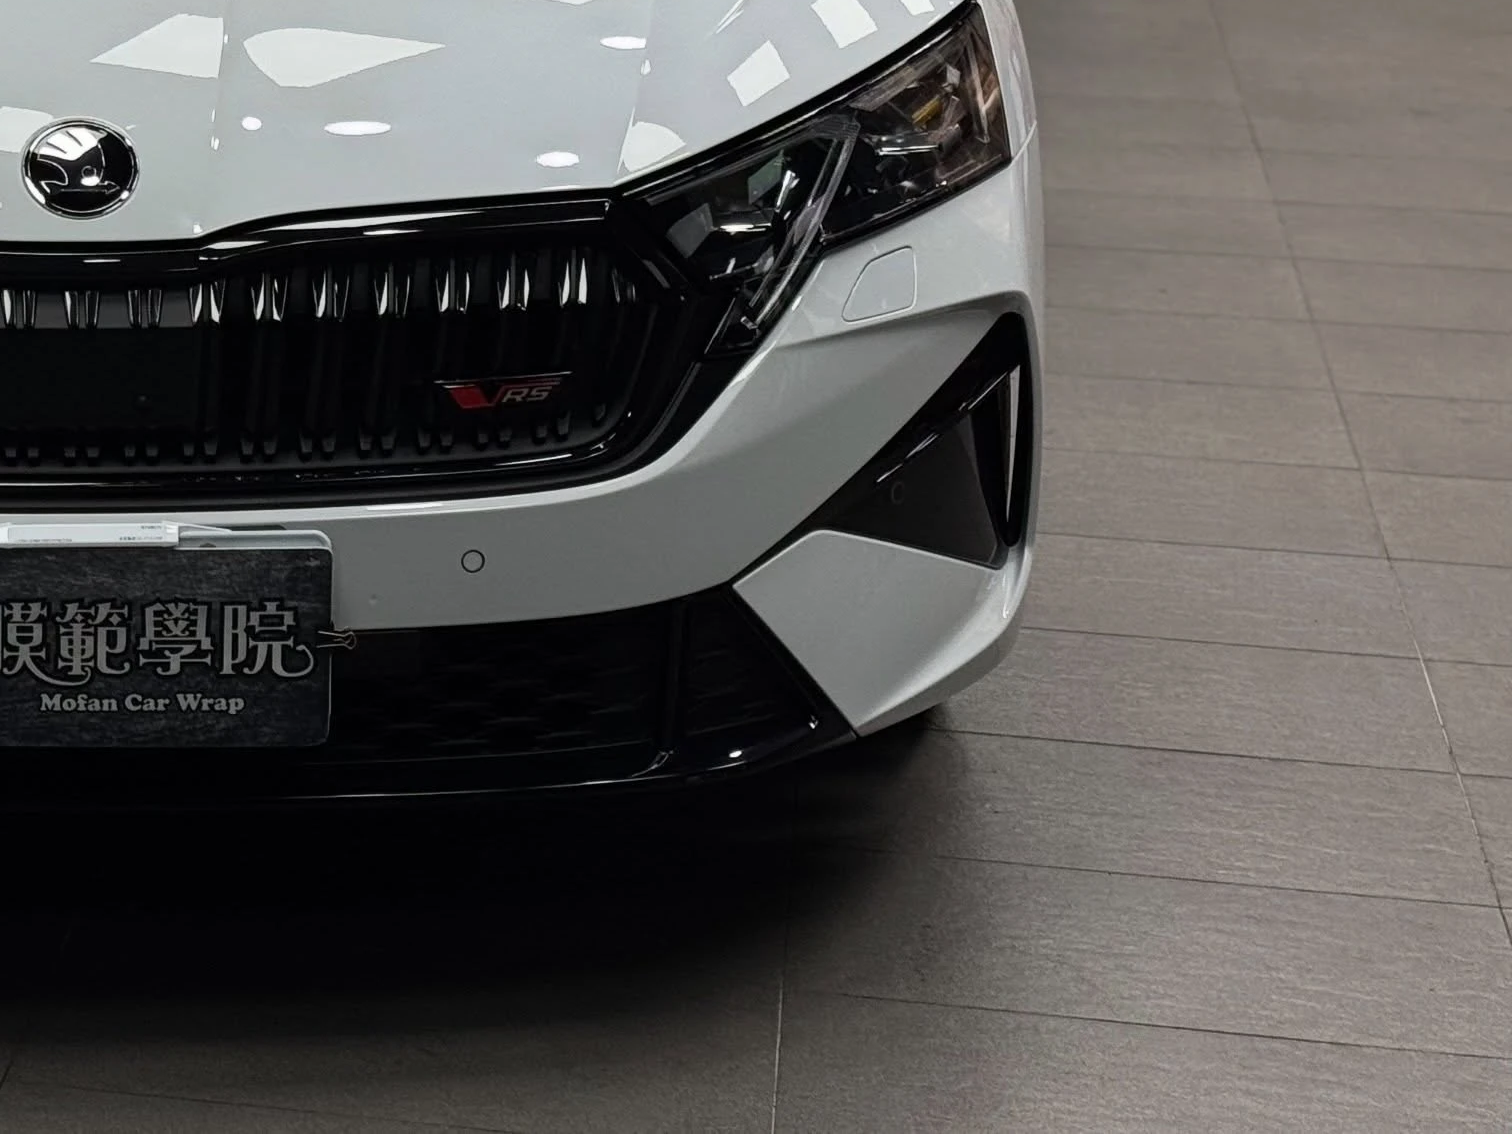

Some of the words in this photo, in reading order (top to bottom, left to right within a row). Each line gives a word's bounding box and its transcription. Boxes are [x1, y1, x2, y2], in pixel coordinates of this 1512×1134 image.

[40, 693, 119, 712] Mofan
[124, 693, 170, 712] Car
[176, 693, 245, 715] Wrap
